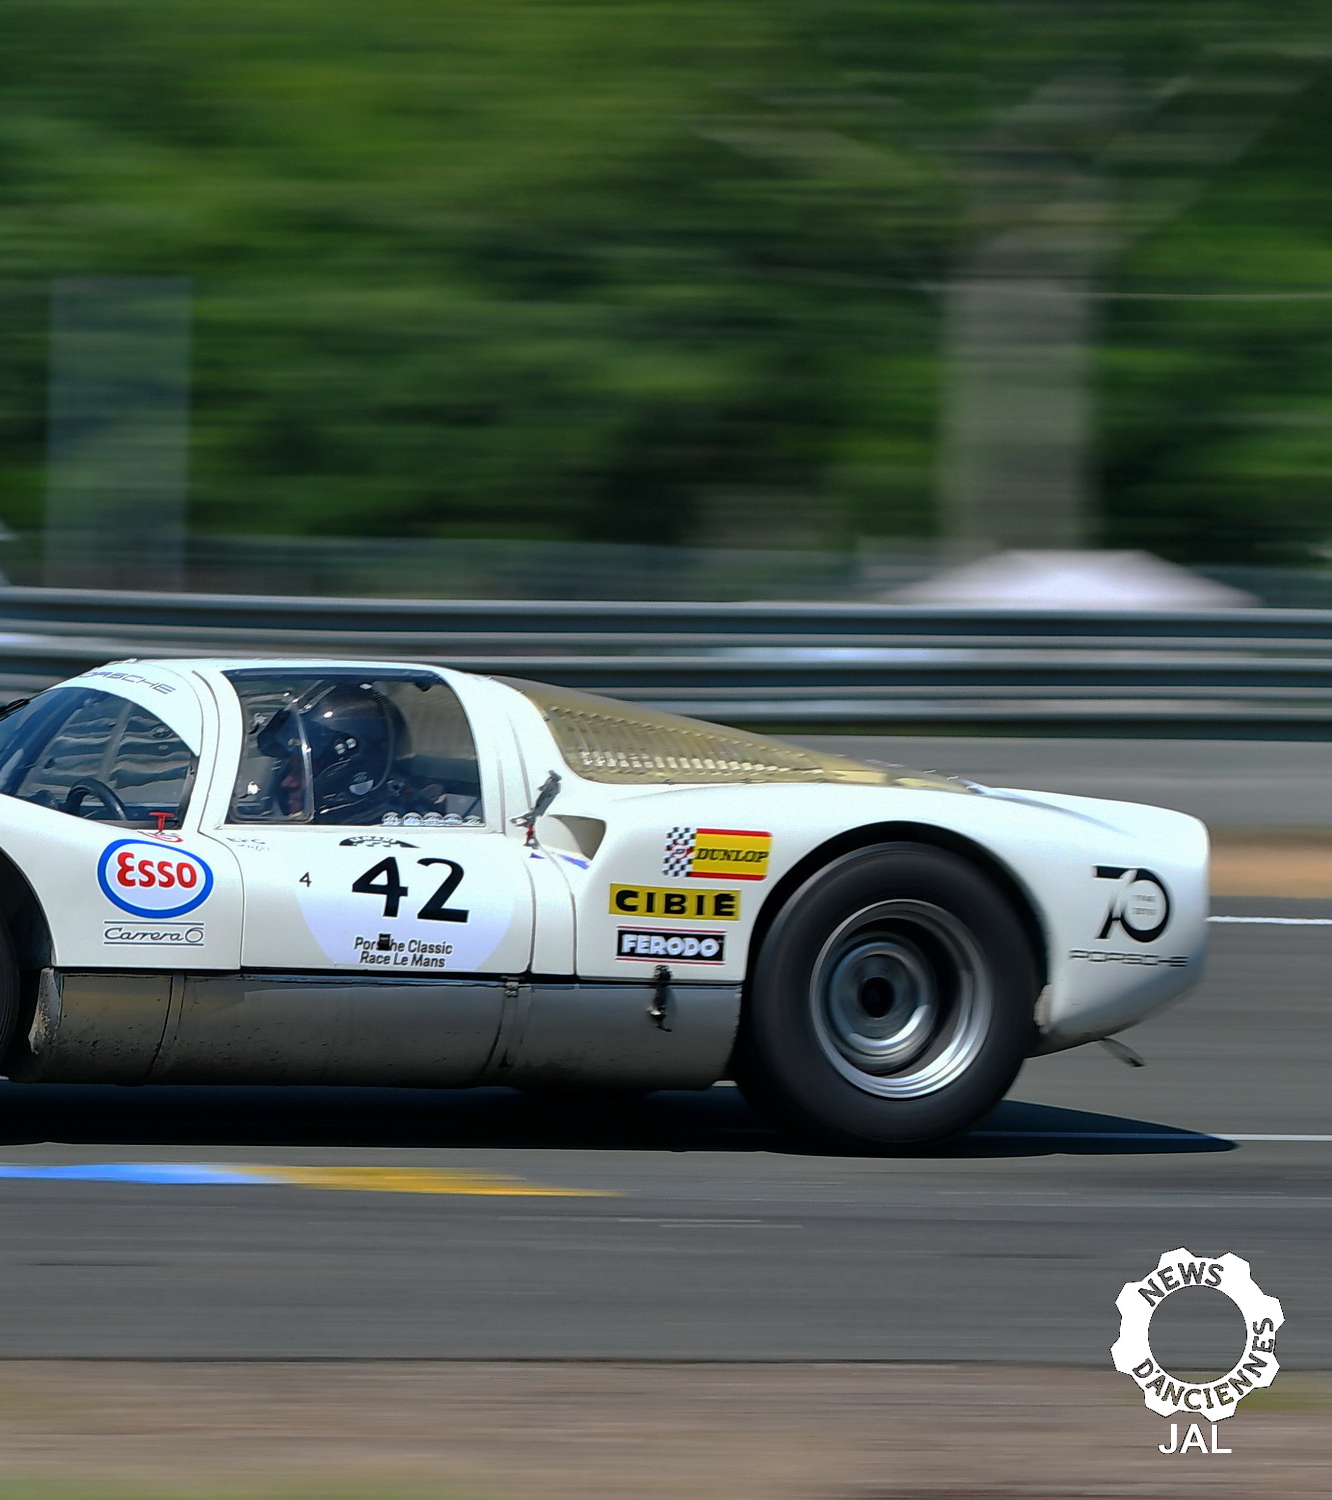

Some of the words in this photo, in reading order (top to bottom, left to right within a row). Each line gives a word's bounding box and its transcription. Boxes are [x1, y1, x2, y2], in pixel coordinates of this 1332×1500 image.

[696, 848, 769, 863] DUNLOP
[299, 872, 312, 888] 4
[351, 856, 471, 923] 42
[1092, 865, 1172, 943] 70
[104, 927, 184, 941] Carrera
[185, 927, 204, 943] 6
[354, 936, 405, 951] Porhe
[408, 939, 453, 954] Classic
[621, 933, 720, 957] FERODO
[359, 951, 391, 965] Race
[393, 953, 408, 966] Le
[410, 954, 445, 968] Mans
[1069, 949, 1189, 967] PORSCHE
